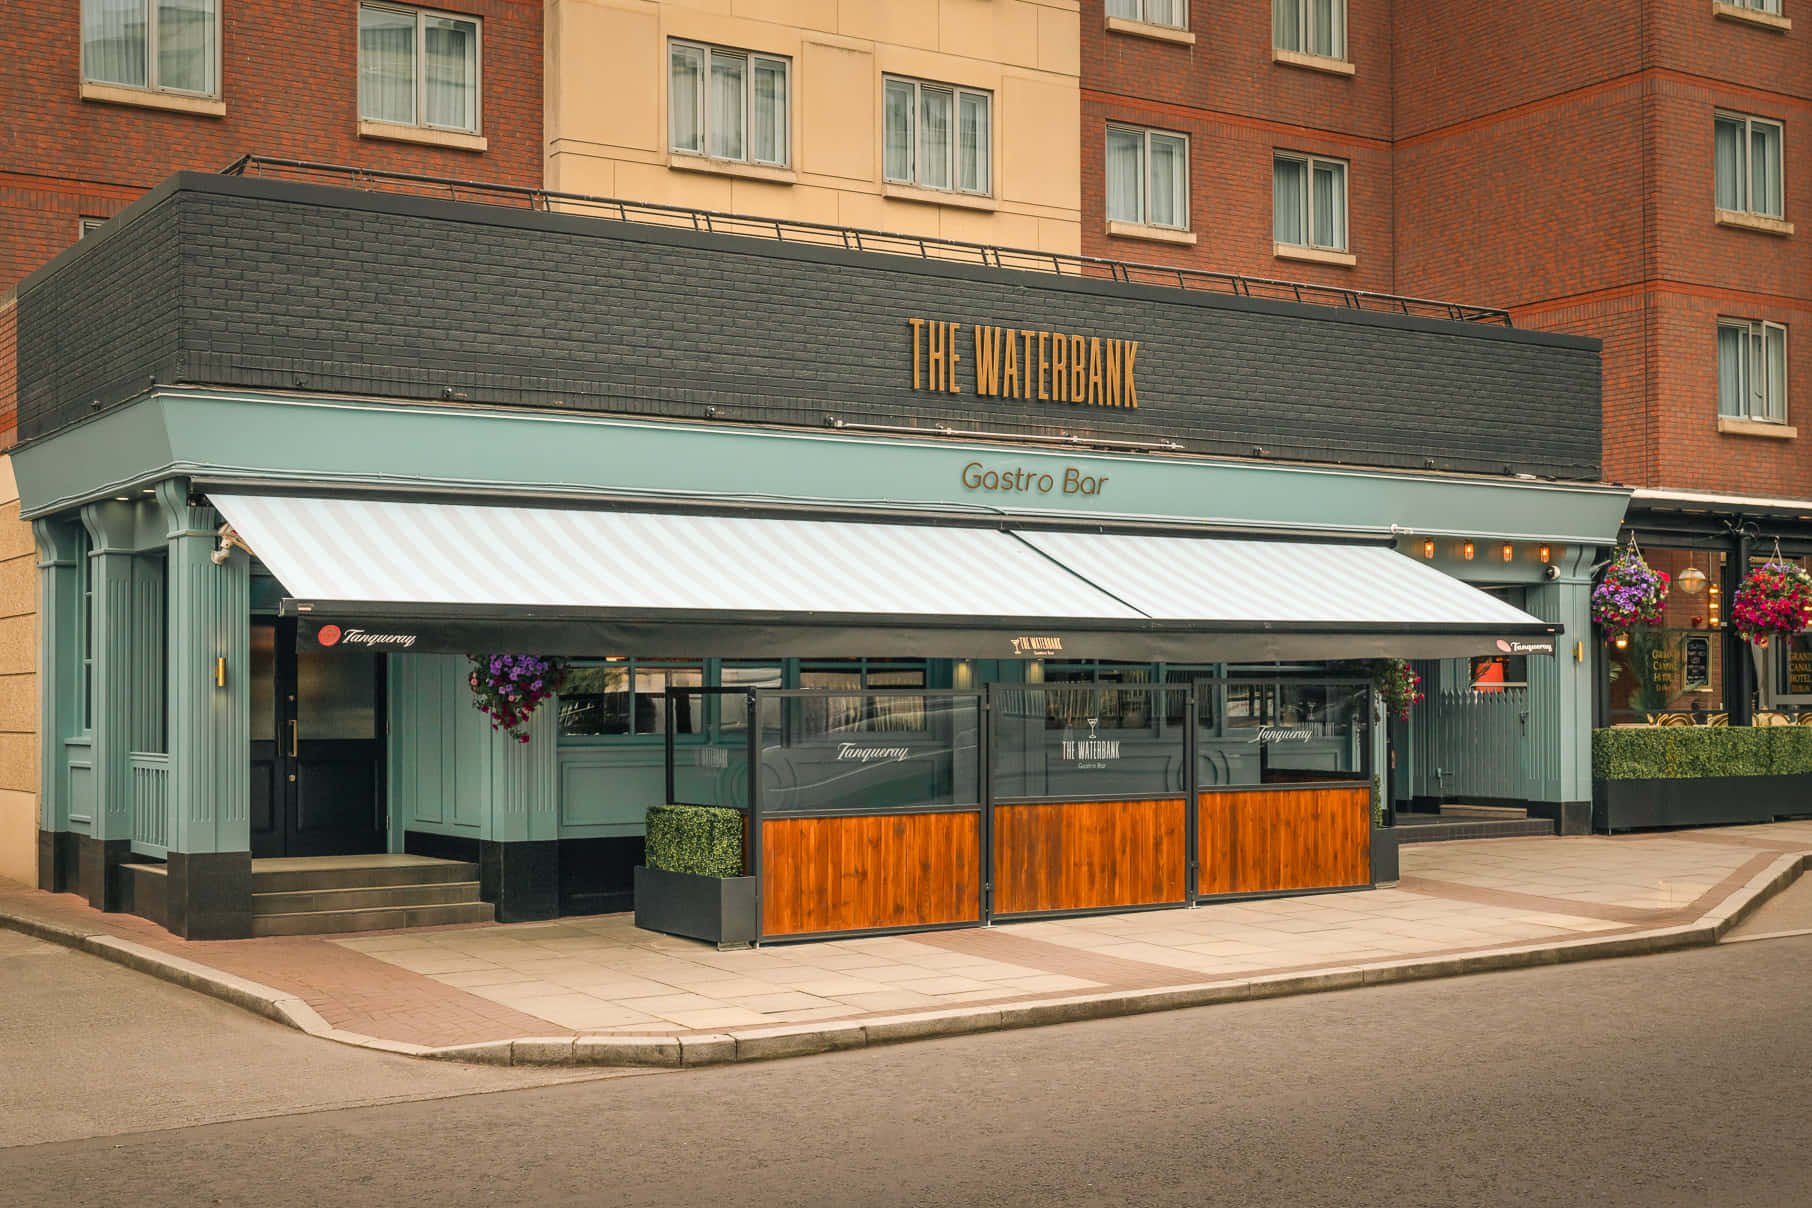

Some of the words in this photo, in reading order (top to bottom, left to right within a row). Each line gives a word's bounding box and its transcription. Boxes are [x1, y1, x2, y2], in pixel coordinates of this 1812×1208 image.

[908, 317, 961, 393] THE
[975, 324, 1139, 408] WATERBANK
[962, 462, 1054, 493] Gastro
[1063, 467, 1109, 496] Bar
[342, 628, 417, 648] Tanqueray
[1510, 641, 1553, 652] Tanqueray
[1248, 725, 1313, 743] Tanqueray
[837, 742, 909, 762] Tanqueray
[1063, 740, 1075, 760] THE
[1078, 740, 1120, 760] WATERBANK
